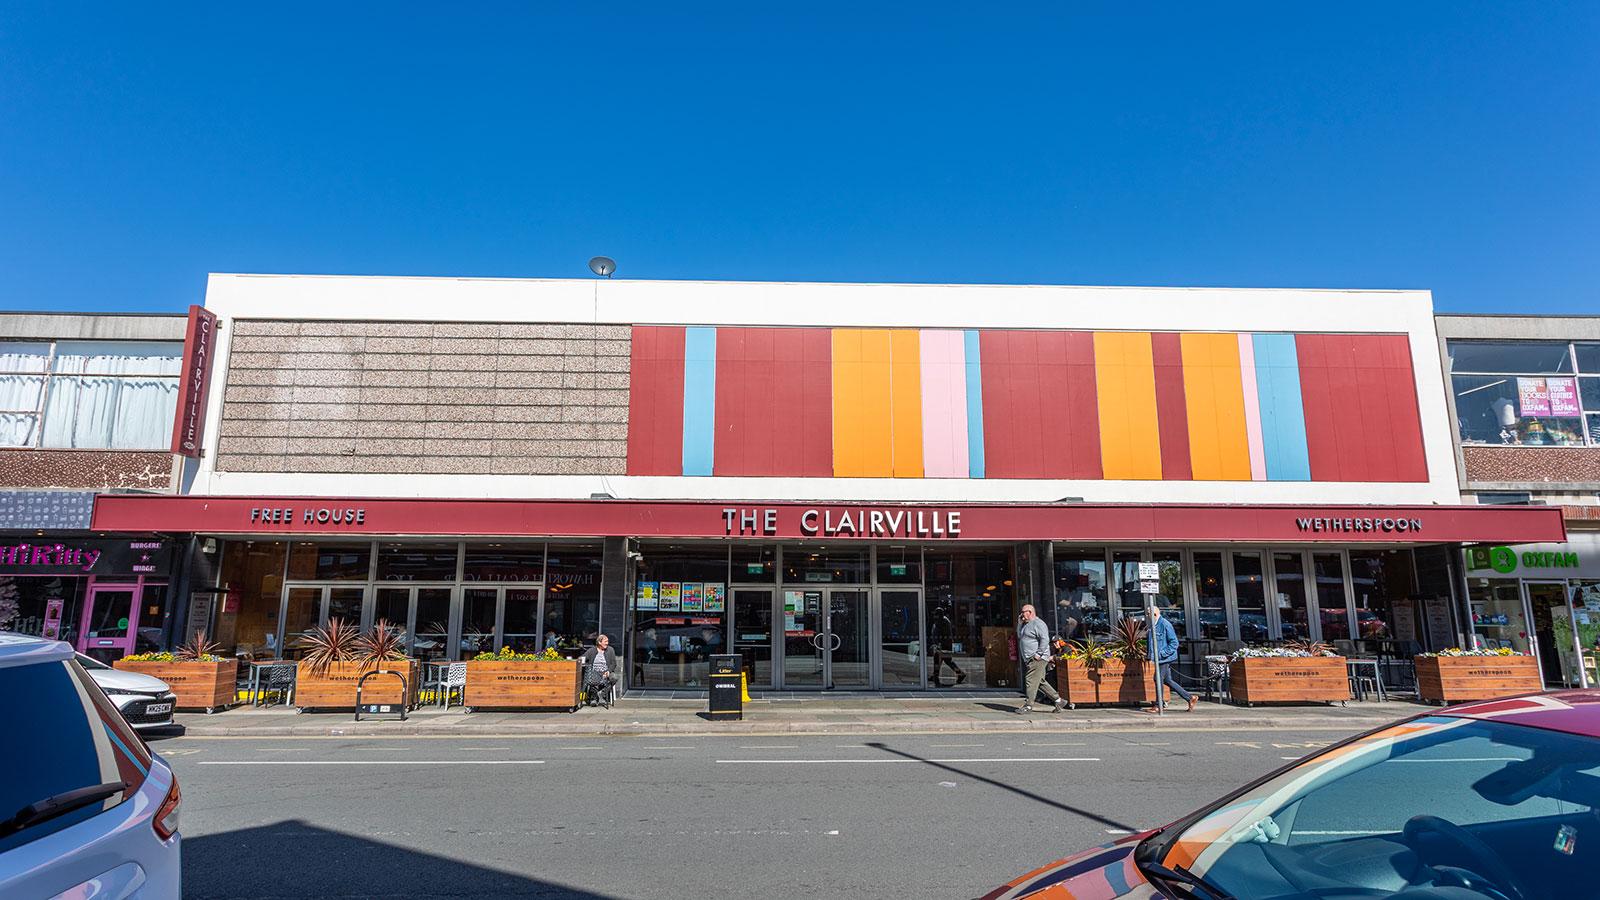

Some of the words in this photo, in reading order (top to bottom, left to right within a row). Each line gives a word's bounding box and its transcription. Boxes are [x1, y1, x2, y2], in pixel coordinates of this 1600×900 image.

[188, 320, 209, 440] CLAIRVILLE
[251, 508, 293, 522] FREE
[303, 508, 366, 523] HOUSE
[722, 508, 777, 533] THE
[801, 509, 961, 534] CLAIRVILLE
[1297, 517, 1422, 531] WETHERSPOON
[1521, 551, 1579, 568] OXFAM
